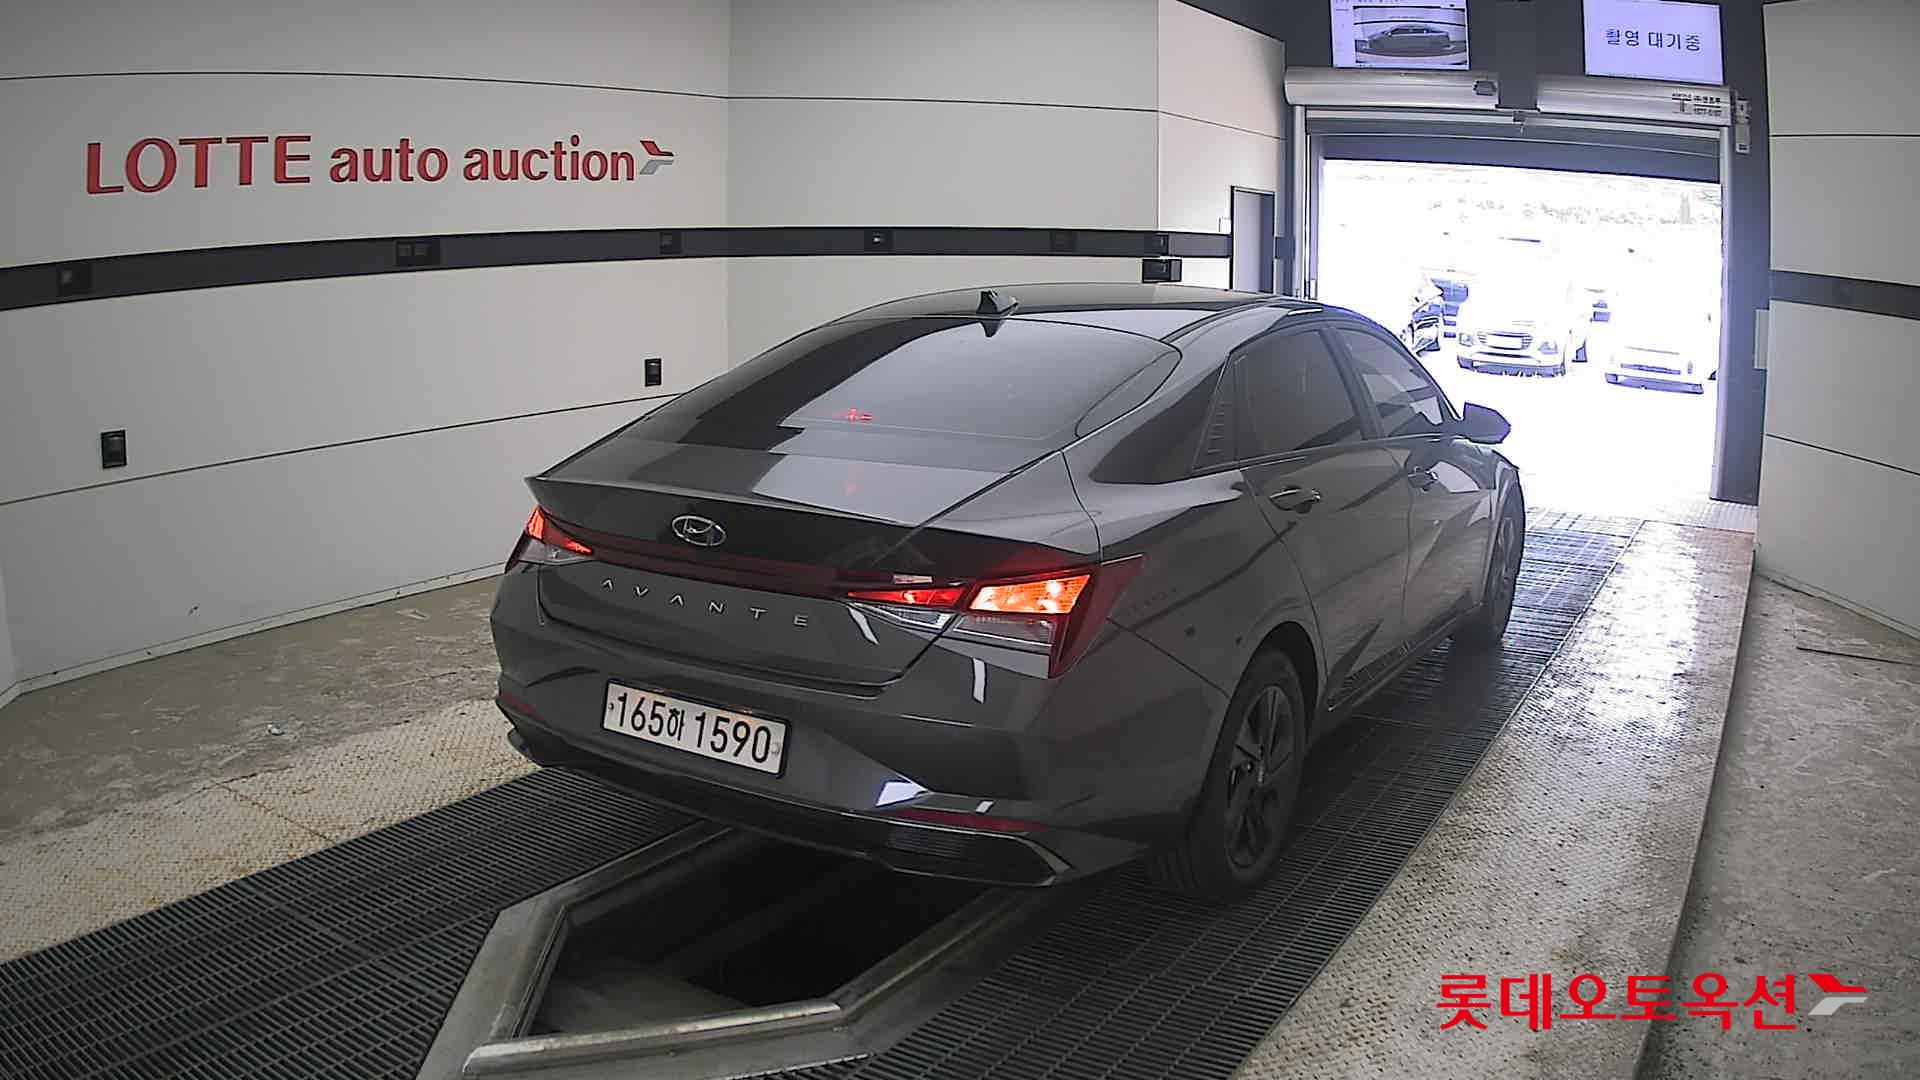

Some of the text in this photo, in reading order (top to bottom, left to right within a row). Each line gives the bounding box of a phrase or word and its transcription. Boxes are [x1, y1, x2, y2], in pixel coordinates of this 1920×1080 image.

[86, 135, 635, 194] LOTTE auto auction
[601, 578, 809, 626] AVANTE
[695, 711, 772, 763] 1590
